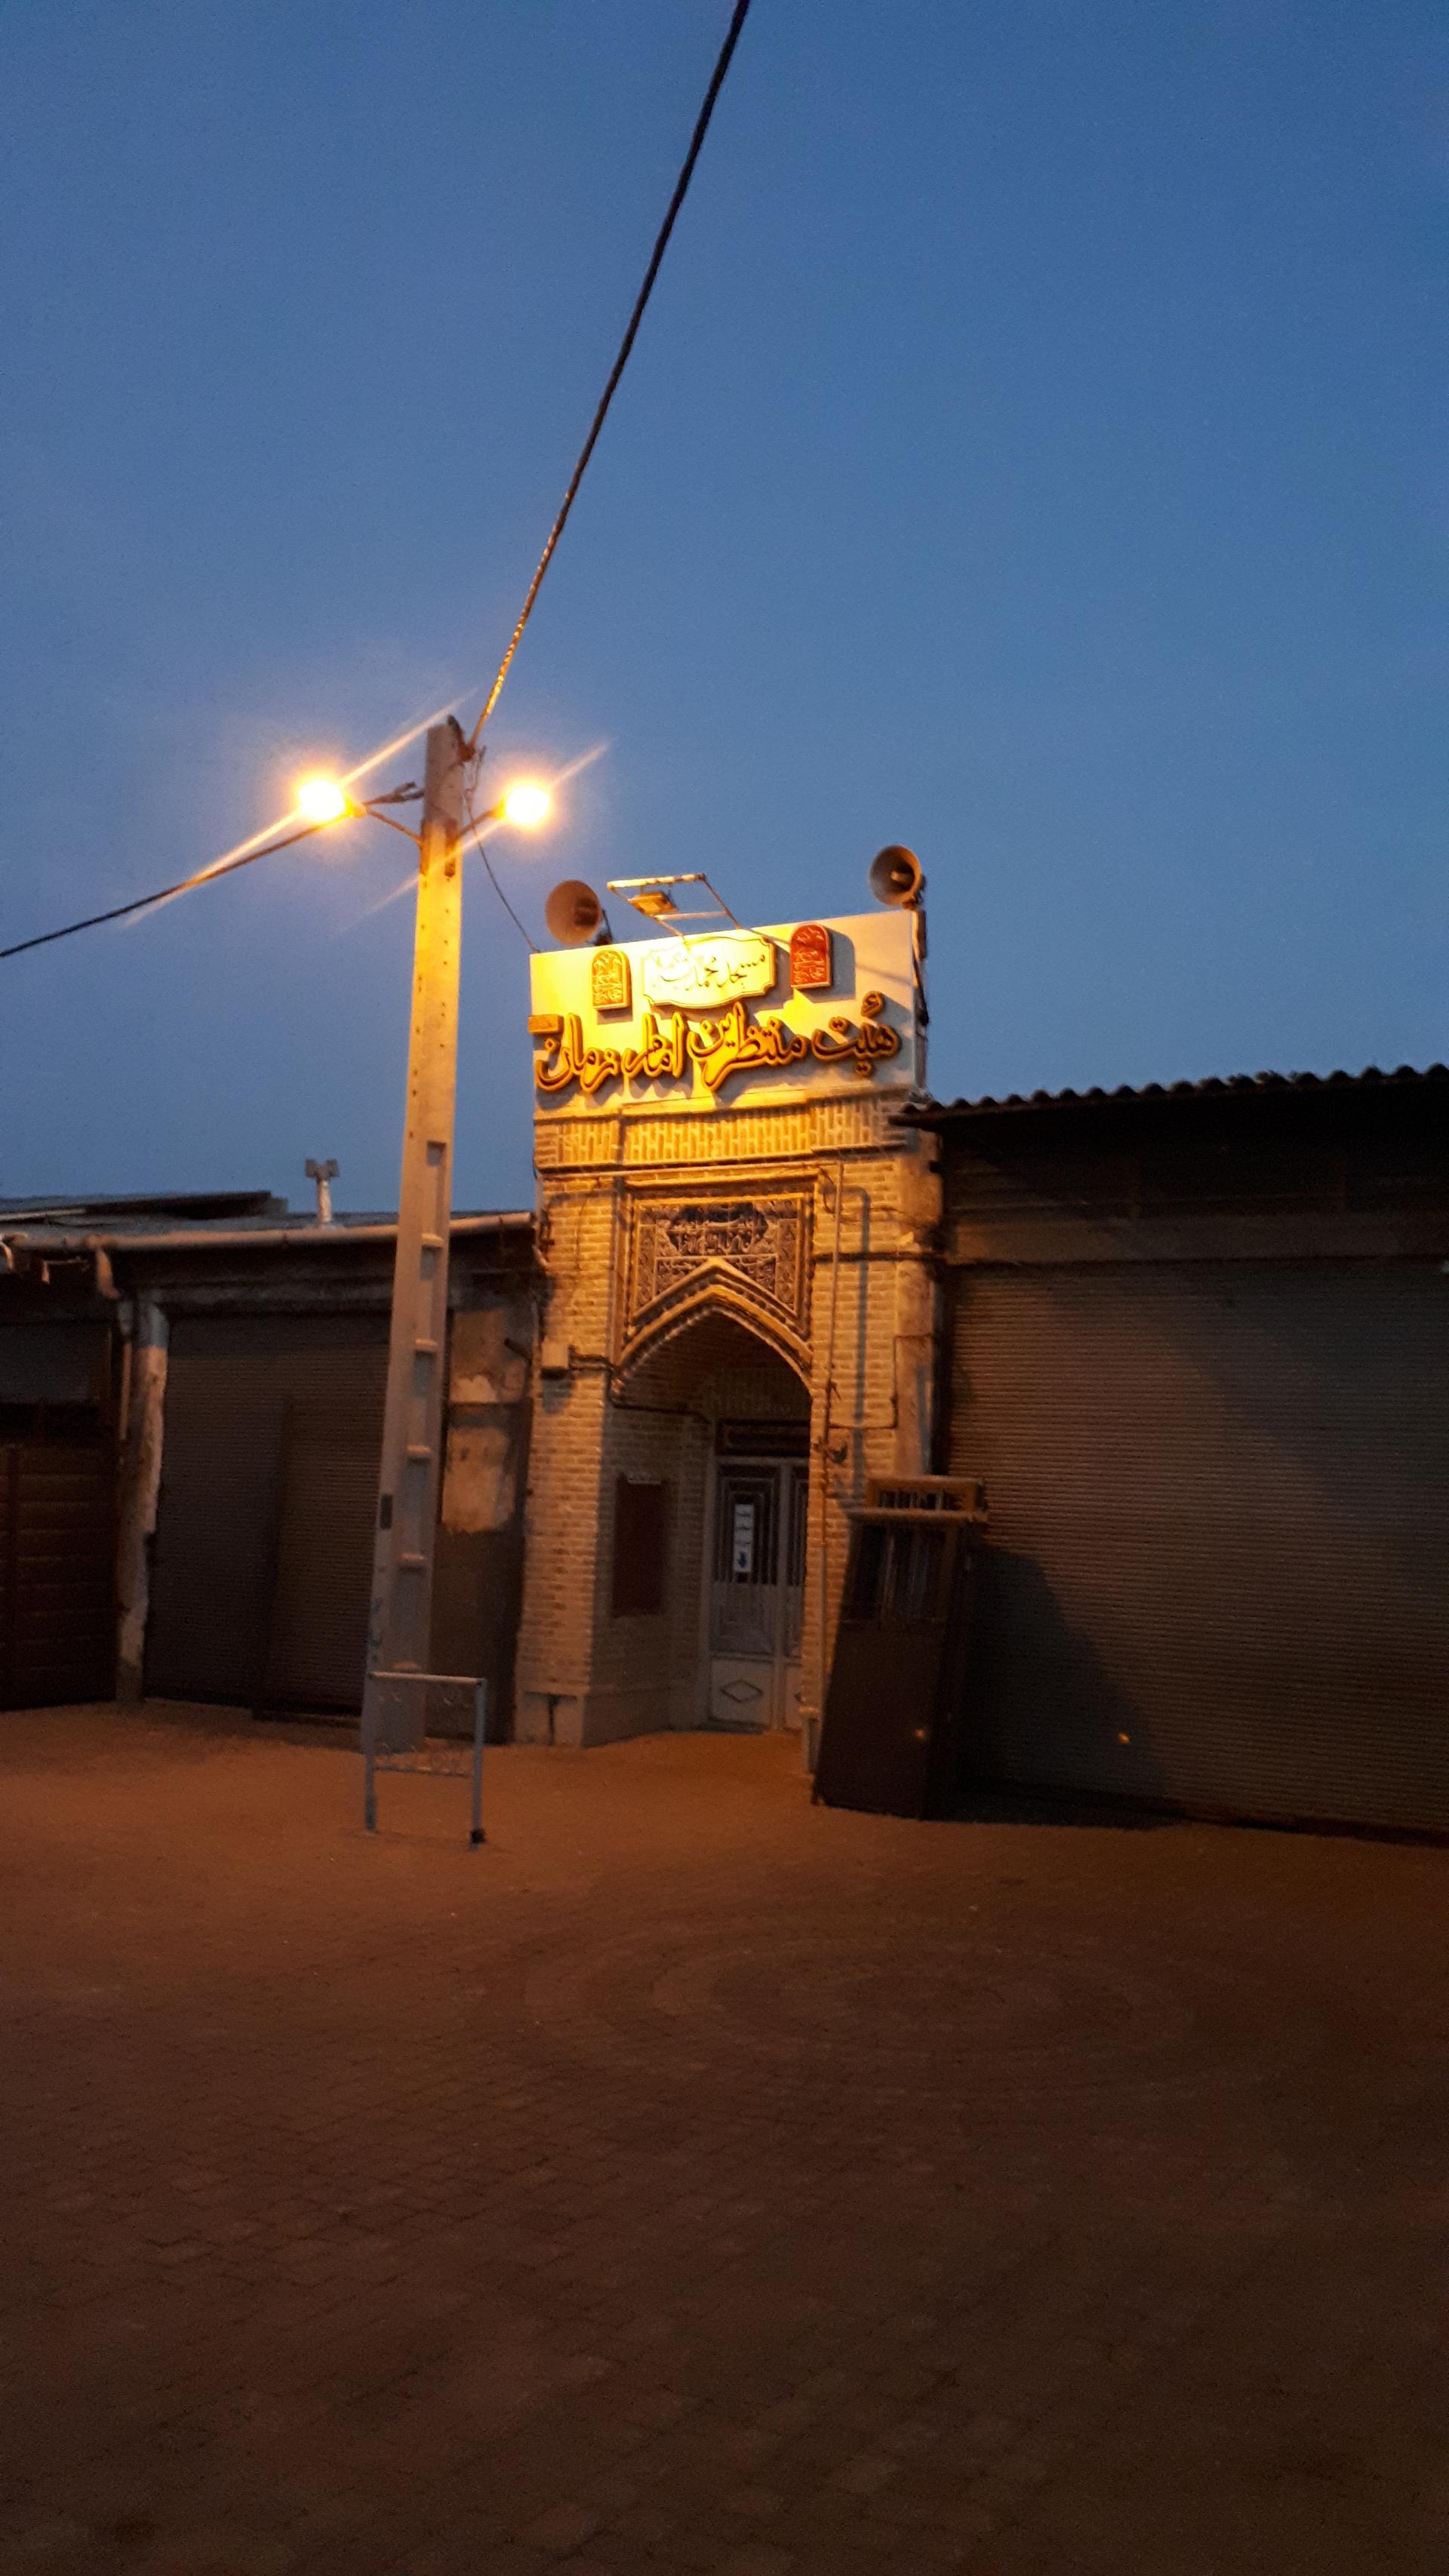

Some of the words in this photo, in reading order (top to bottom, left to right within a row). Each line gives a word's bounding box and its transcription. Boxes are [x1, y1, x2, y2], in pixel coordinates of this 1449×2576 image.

[716, 954, 765, 989] مسجد
[534, 1012, 621, 1094] زمان
[621, 1011, 685, 1079] امام
